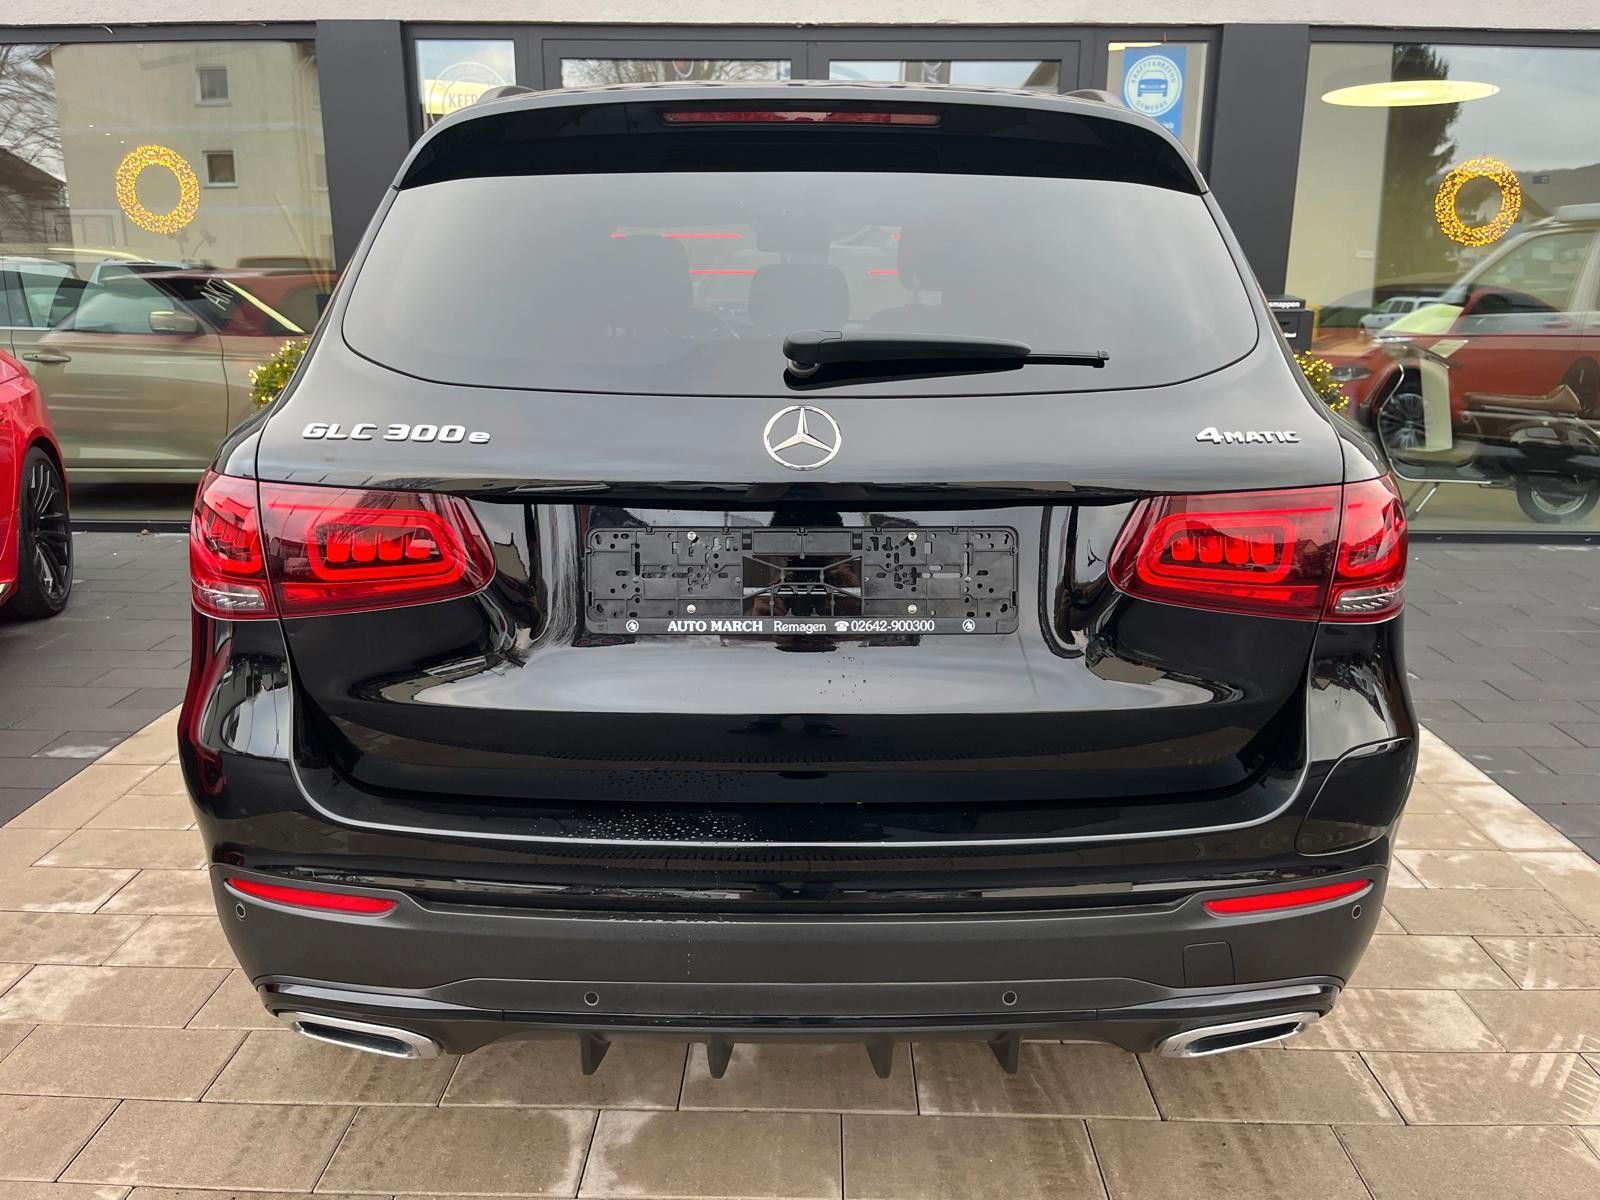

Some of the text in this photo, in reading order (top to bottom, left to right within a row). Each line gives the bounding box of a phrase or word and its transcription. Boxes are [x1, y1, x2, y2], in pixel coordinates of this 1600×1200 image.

[302, 422, 378, 440] GLC
[1196, 427, 1301, 444] 4MATIC
[667, 619, 935, 634] AUTO MARCH Remagen 02642-900300
